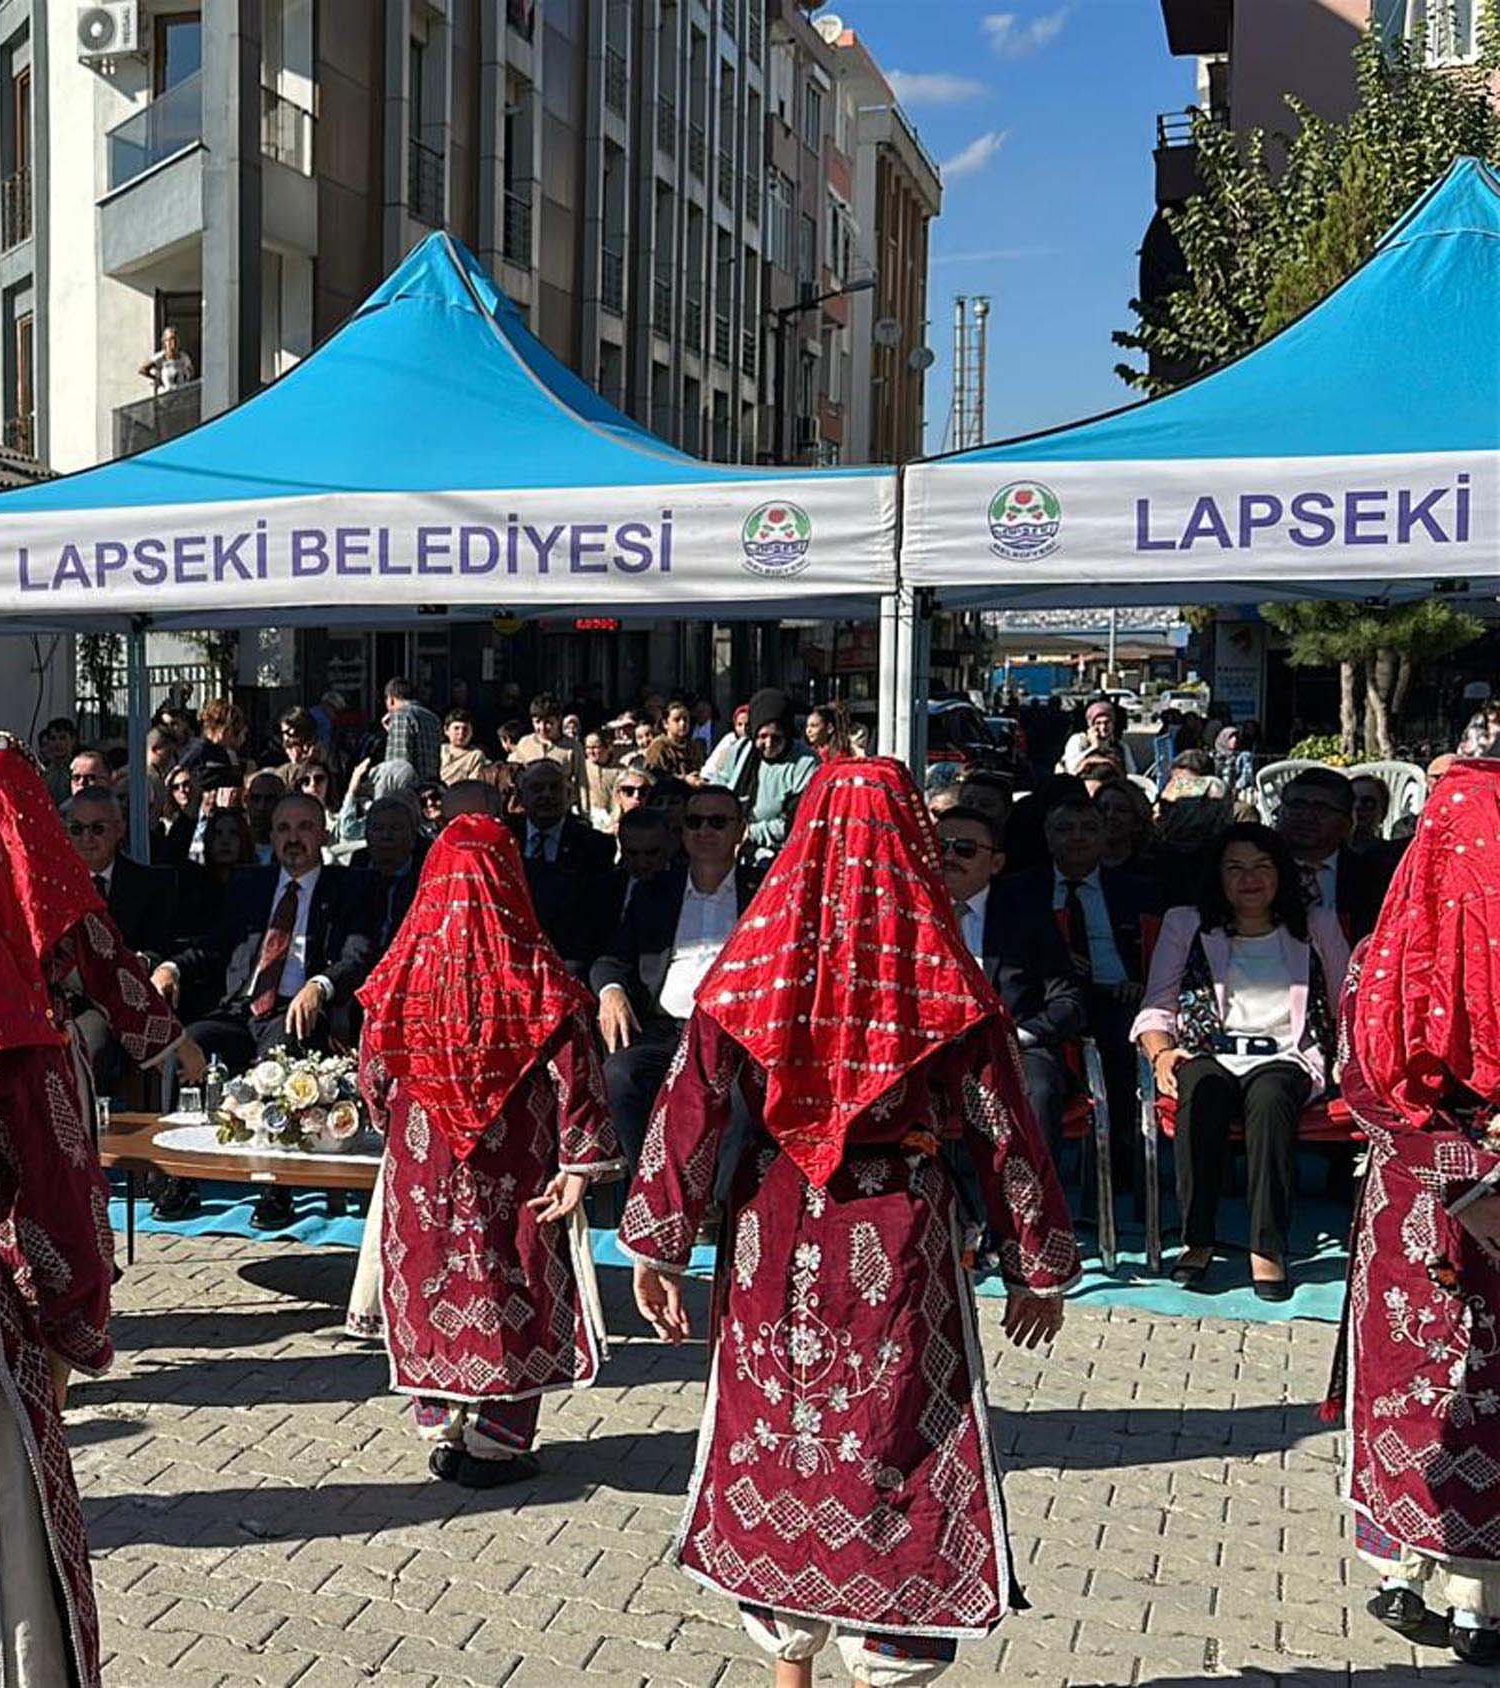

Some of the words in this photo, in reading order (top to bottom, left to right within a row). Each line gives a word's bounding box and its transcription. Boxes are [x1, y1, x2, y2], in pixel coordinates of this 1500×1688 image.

[19, 519, 268, 591] LAPSEKİ
[291, 510, 672, 577] BELEDİYESİ
[1136, 473, 1471, 552] LAPSEKİ
